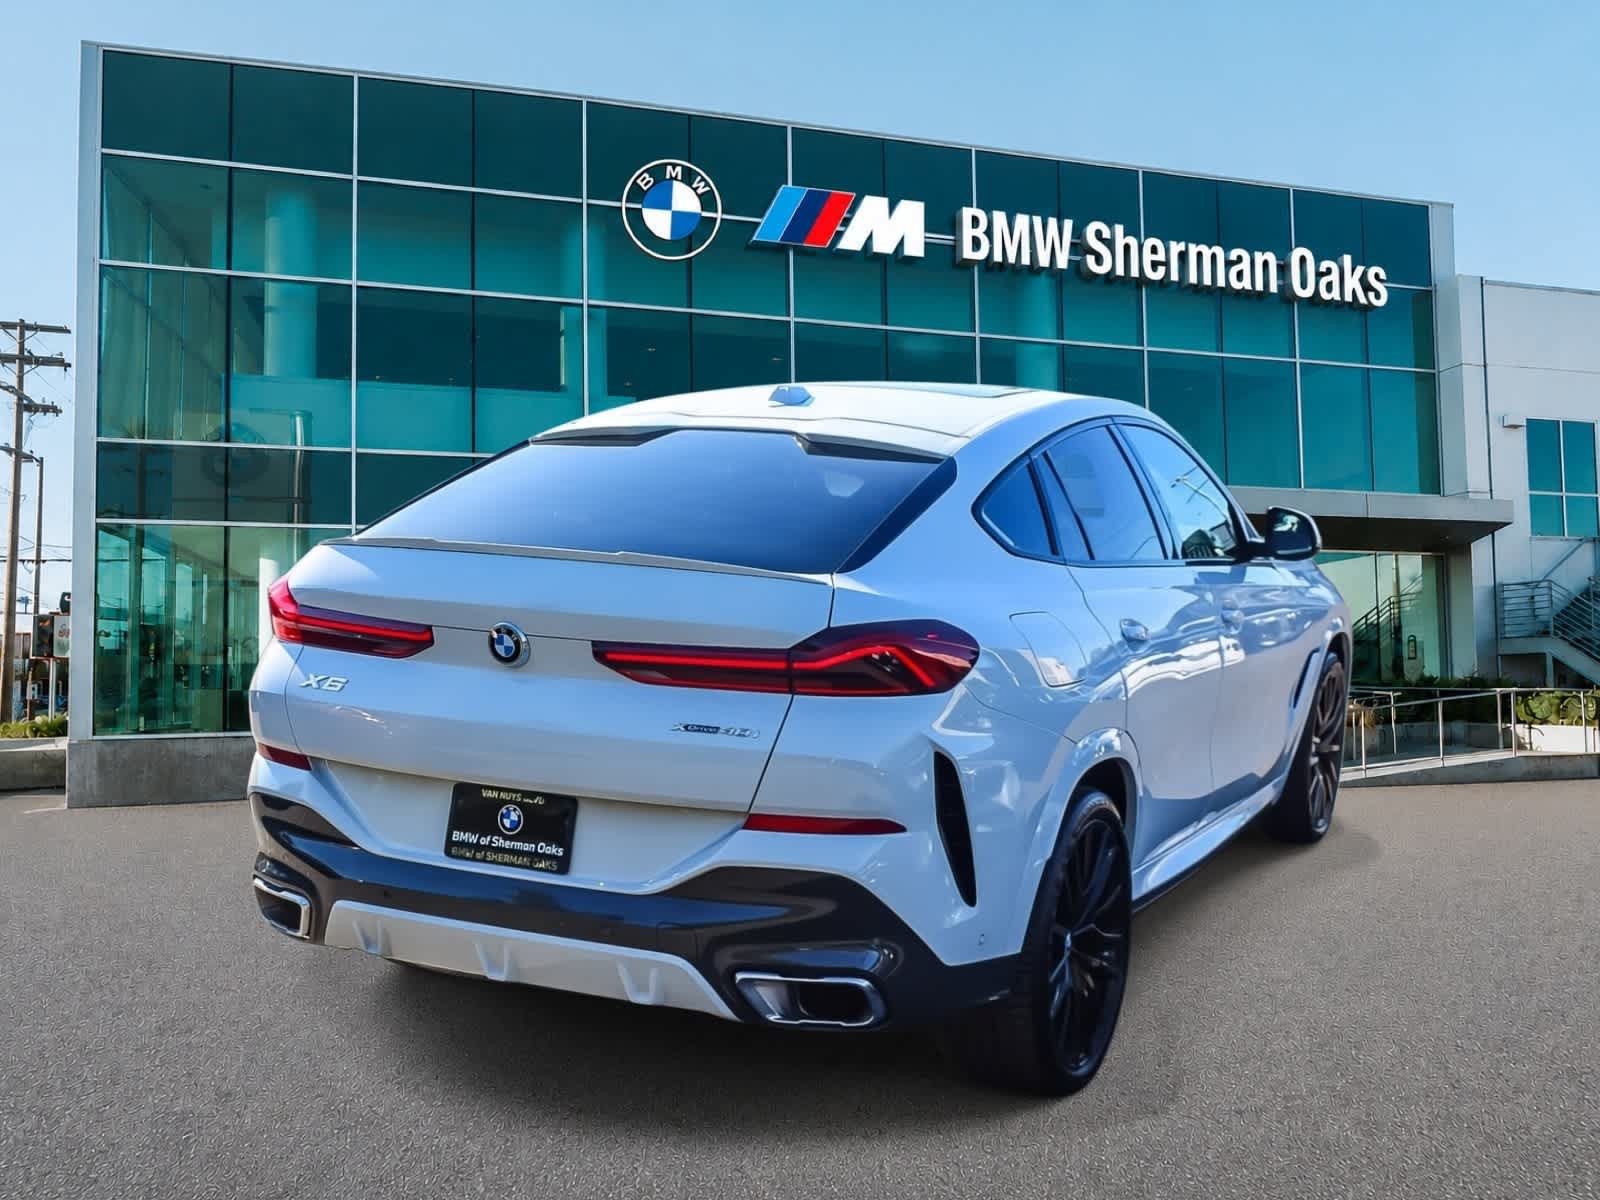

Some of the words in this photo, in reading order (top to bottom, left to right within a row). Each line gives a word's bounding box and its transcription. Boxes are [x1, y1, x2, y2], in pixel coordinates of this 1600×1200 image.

[636, 165, 712, 196] BMW
[959, 205, 1074, 271] BMW
[1082, 219, 1279, 294] Sherman
[1288, 246, 1389, 309] Oaks
[299, 673, 350, 692] X6
[482, 789, 498, 799] VAN
[499, 791, 522, 802] NUYS
[452, 831, 479, 844] BMW
[480, 834, 491, 846] of
[491, 836, 535, 853] Sherman
[537, 842, 564, 857] Oaks
[475, 851, 485, 860] of
[486, 852, 531, 866] SHERMAN
